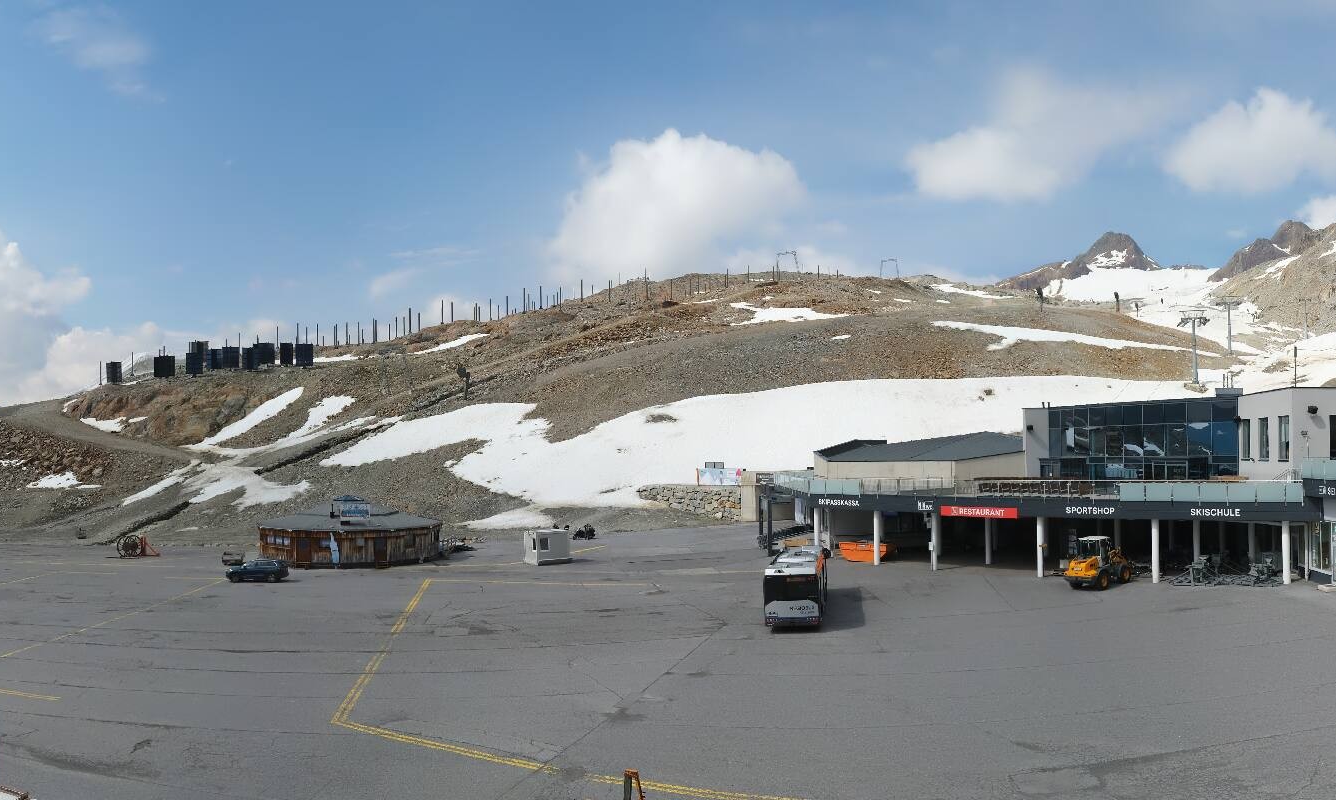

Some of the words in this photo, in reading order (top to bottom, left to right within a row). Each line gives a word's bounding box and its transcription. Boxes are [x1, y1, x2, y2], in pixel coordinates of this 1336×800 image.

[958, 507, 1005, 517] RESTAURANT
[1065, 506, 1115, 515] SPORTSHOP
[1190, 508, 1241, 517] SKISCHULE
